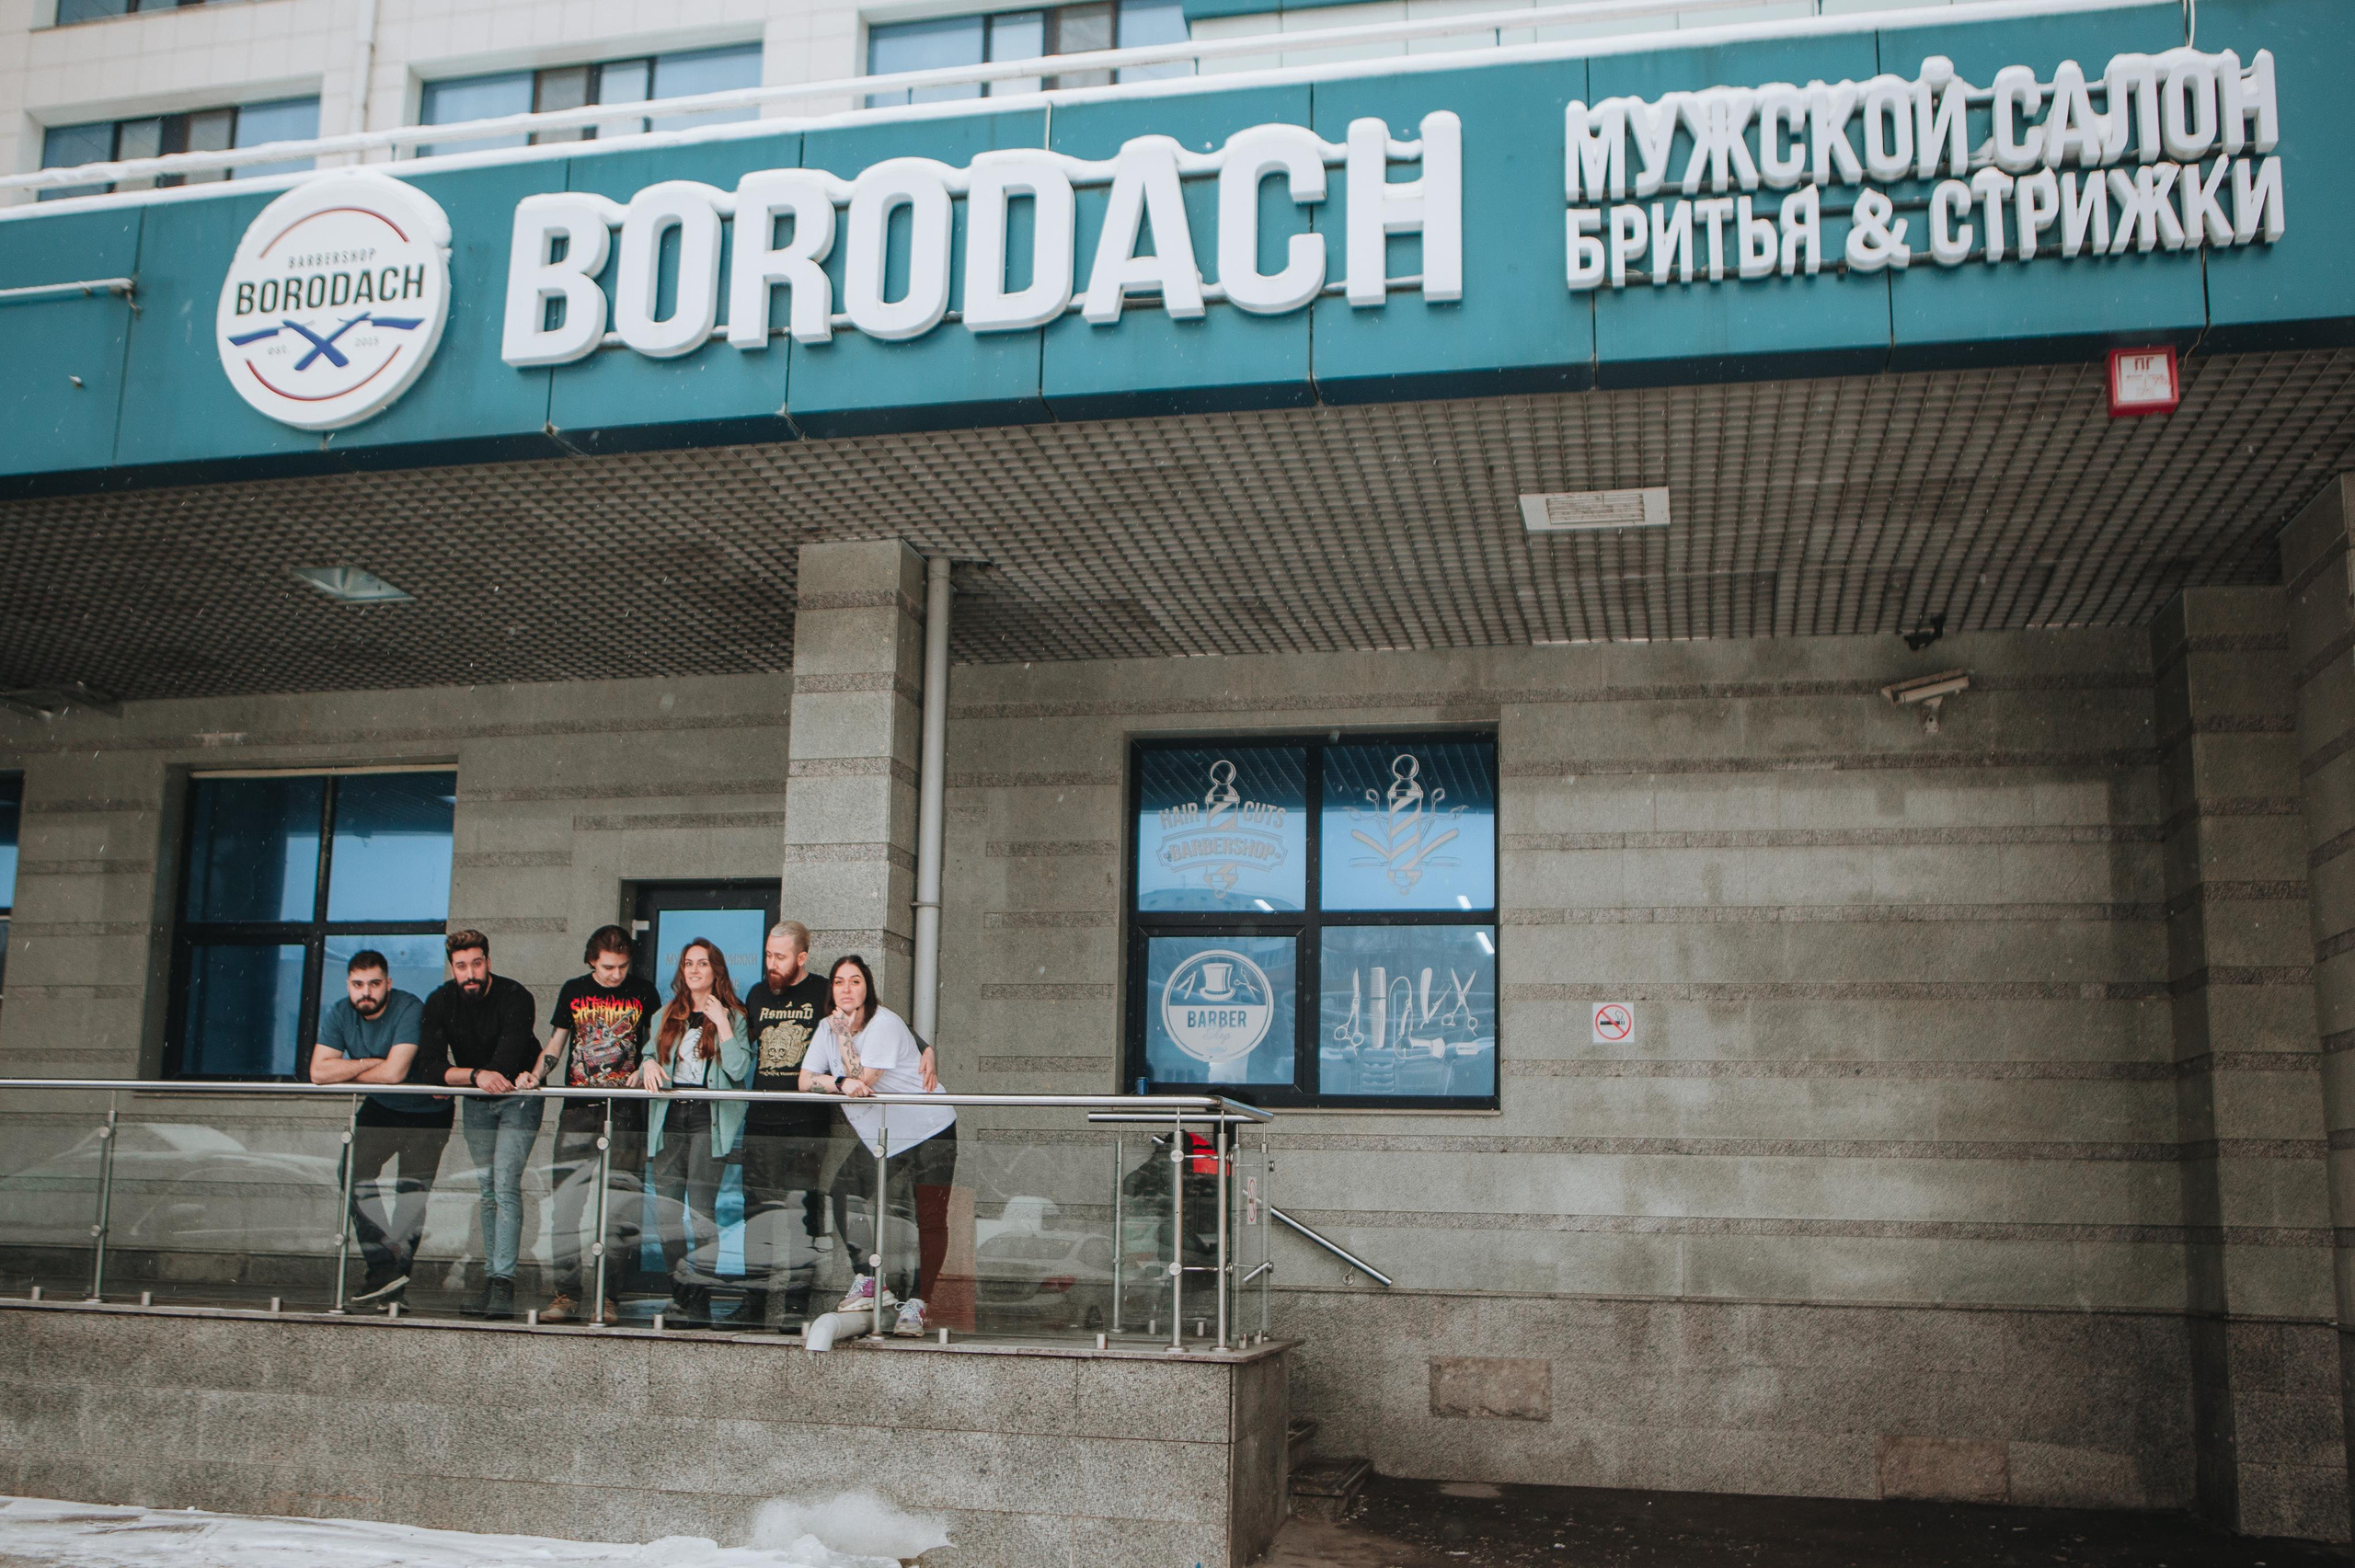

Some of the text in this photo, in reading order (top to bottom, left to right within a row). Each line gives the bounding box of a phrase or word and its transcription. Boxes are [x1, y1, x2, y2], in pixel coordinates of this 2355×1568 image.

[1564, 46, 2280, 203] МУЖСКОЙ САЛОН
[500, 110, 1464, 366] BORODACH
[1565, 155, 2285, 291] БРИТЬЯ & СТРИЖКИ
[288, 247, 376, 269] BARBERSHOP
[236, 263, 424, 315] BORODACH
[1158, 800, 1287, 830] HAIR CUTS
[1169, 837, 1276, 862] BARBERSHOP
[1188, 1011, 1246, 1027] BARBER
